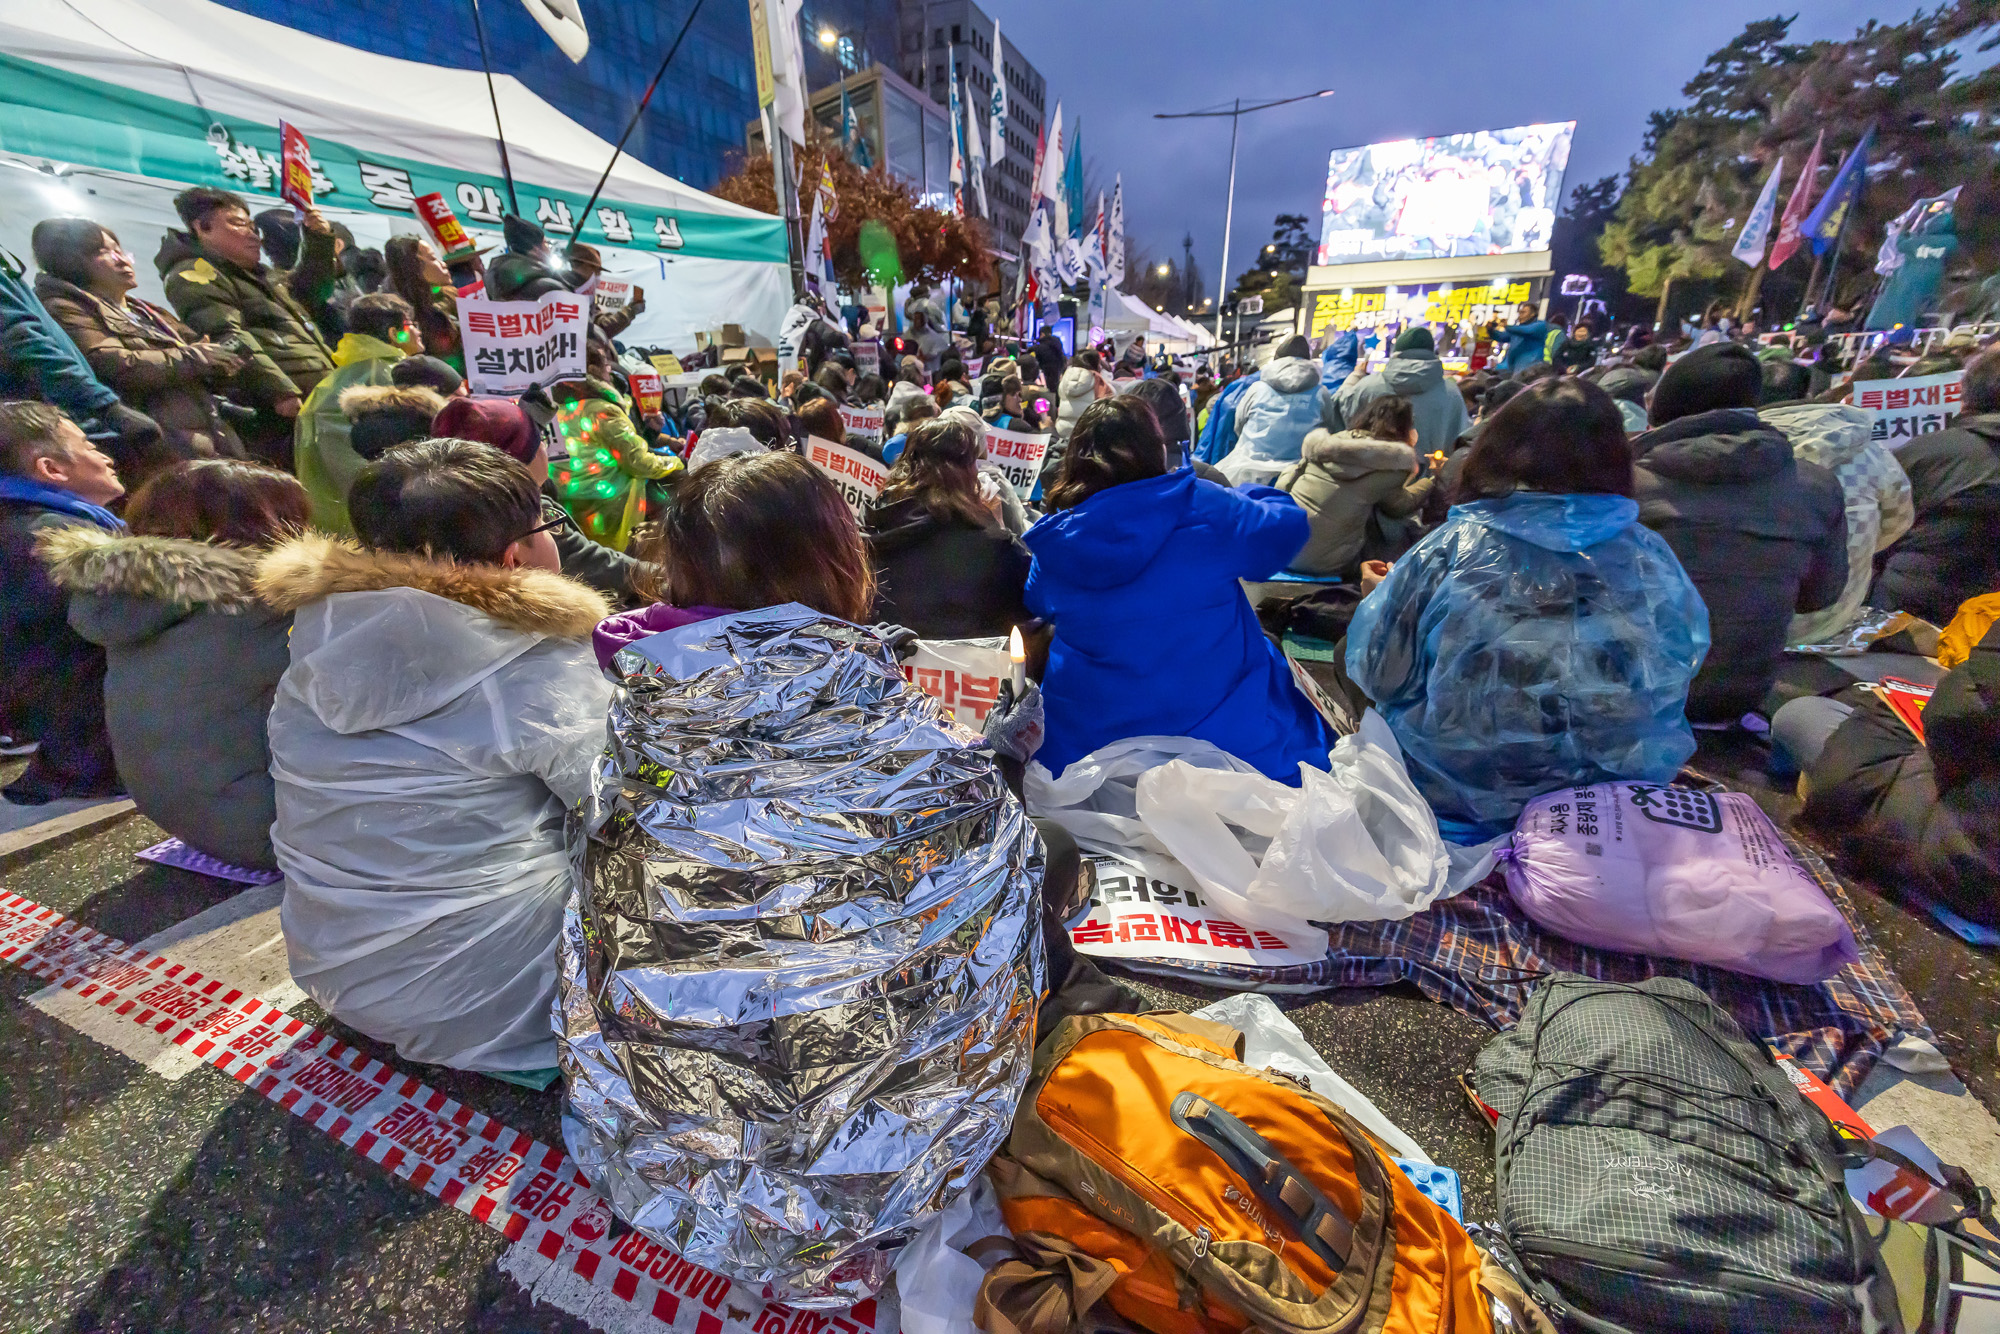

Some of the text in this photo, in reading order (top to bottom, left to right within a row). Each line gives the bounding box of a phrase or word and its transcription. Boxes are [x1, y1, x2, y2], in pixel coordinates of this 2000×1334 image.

[475, 333, 577, 375] 설치하라!
[134, 979, 214, 1020] 안전제일
[192, 1006, 249, 1040] 危險
[227, 1024, 282, 1059] 위험
[288, 1057, 576, 1222] 위험 危險 안전제일 DANGER!
